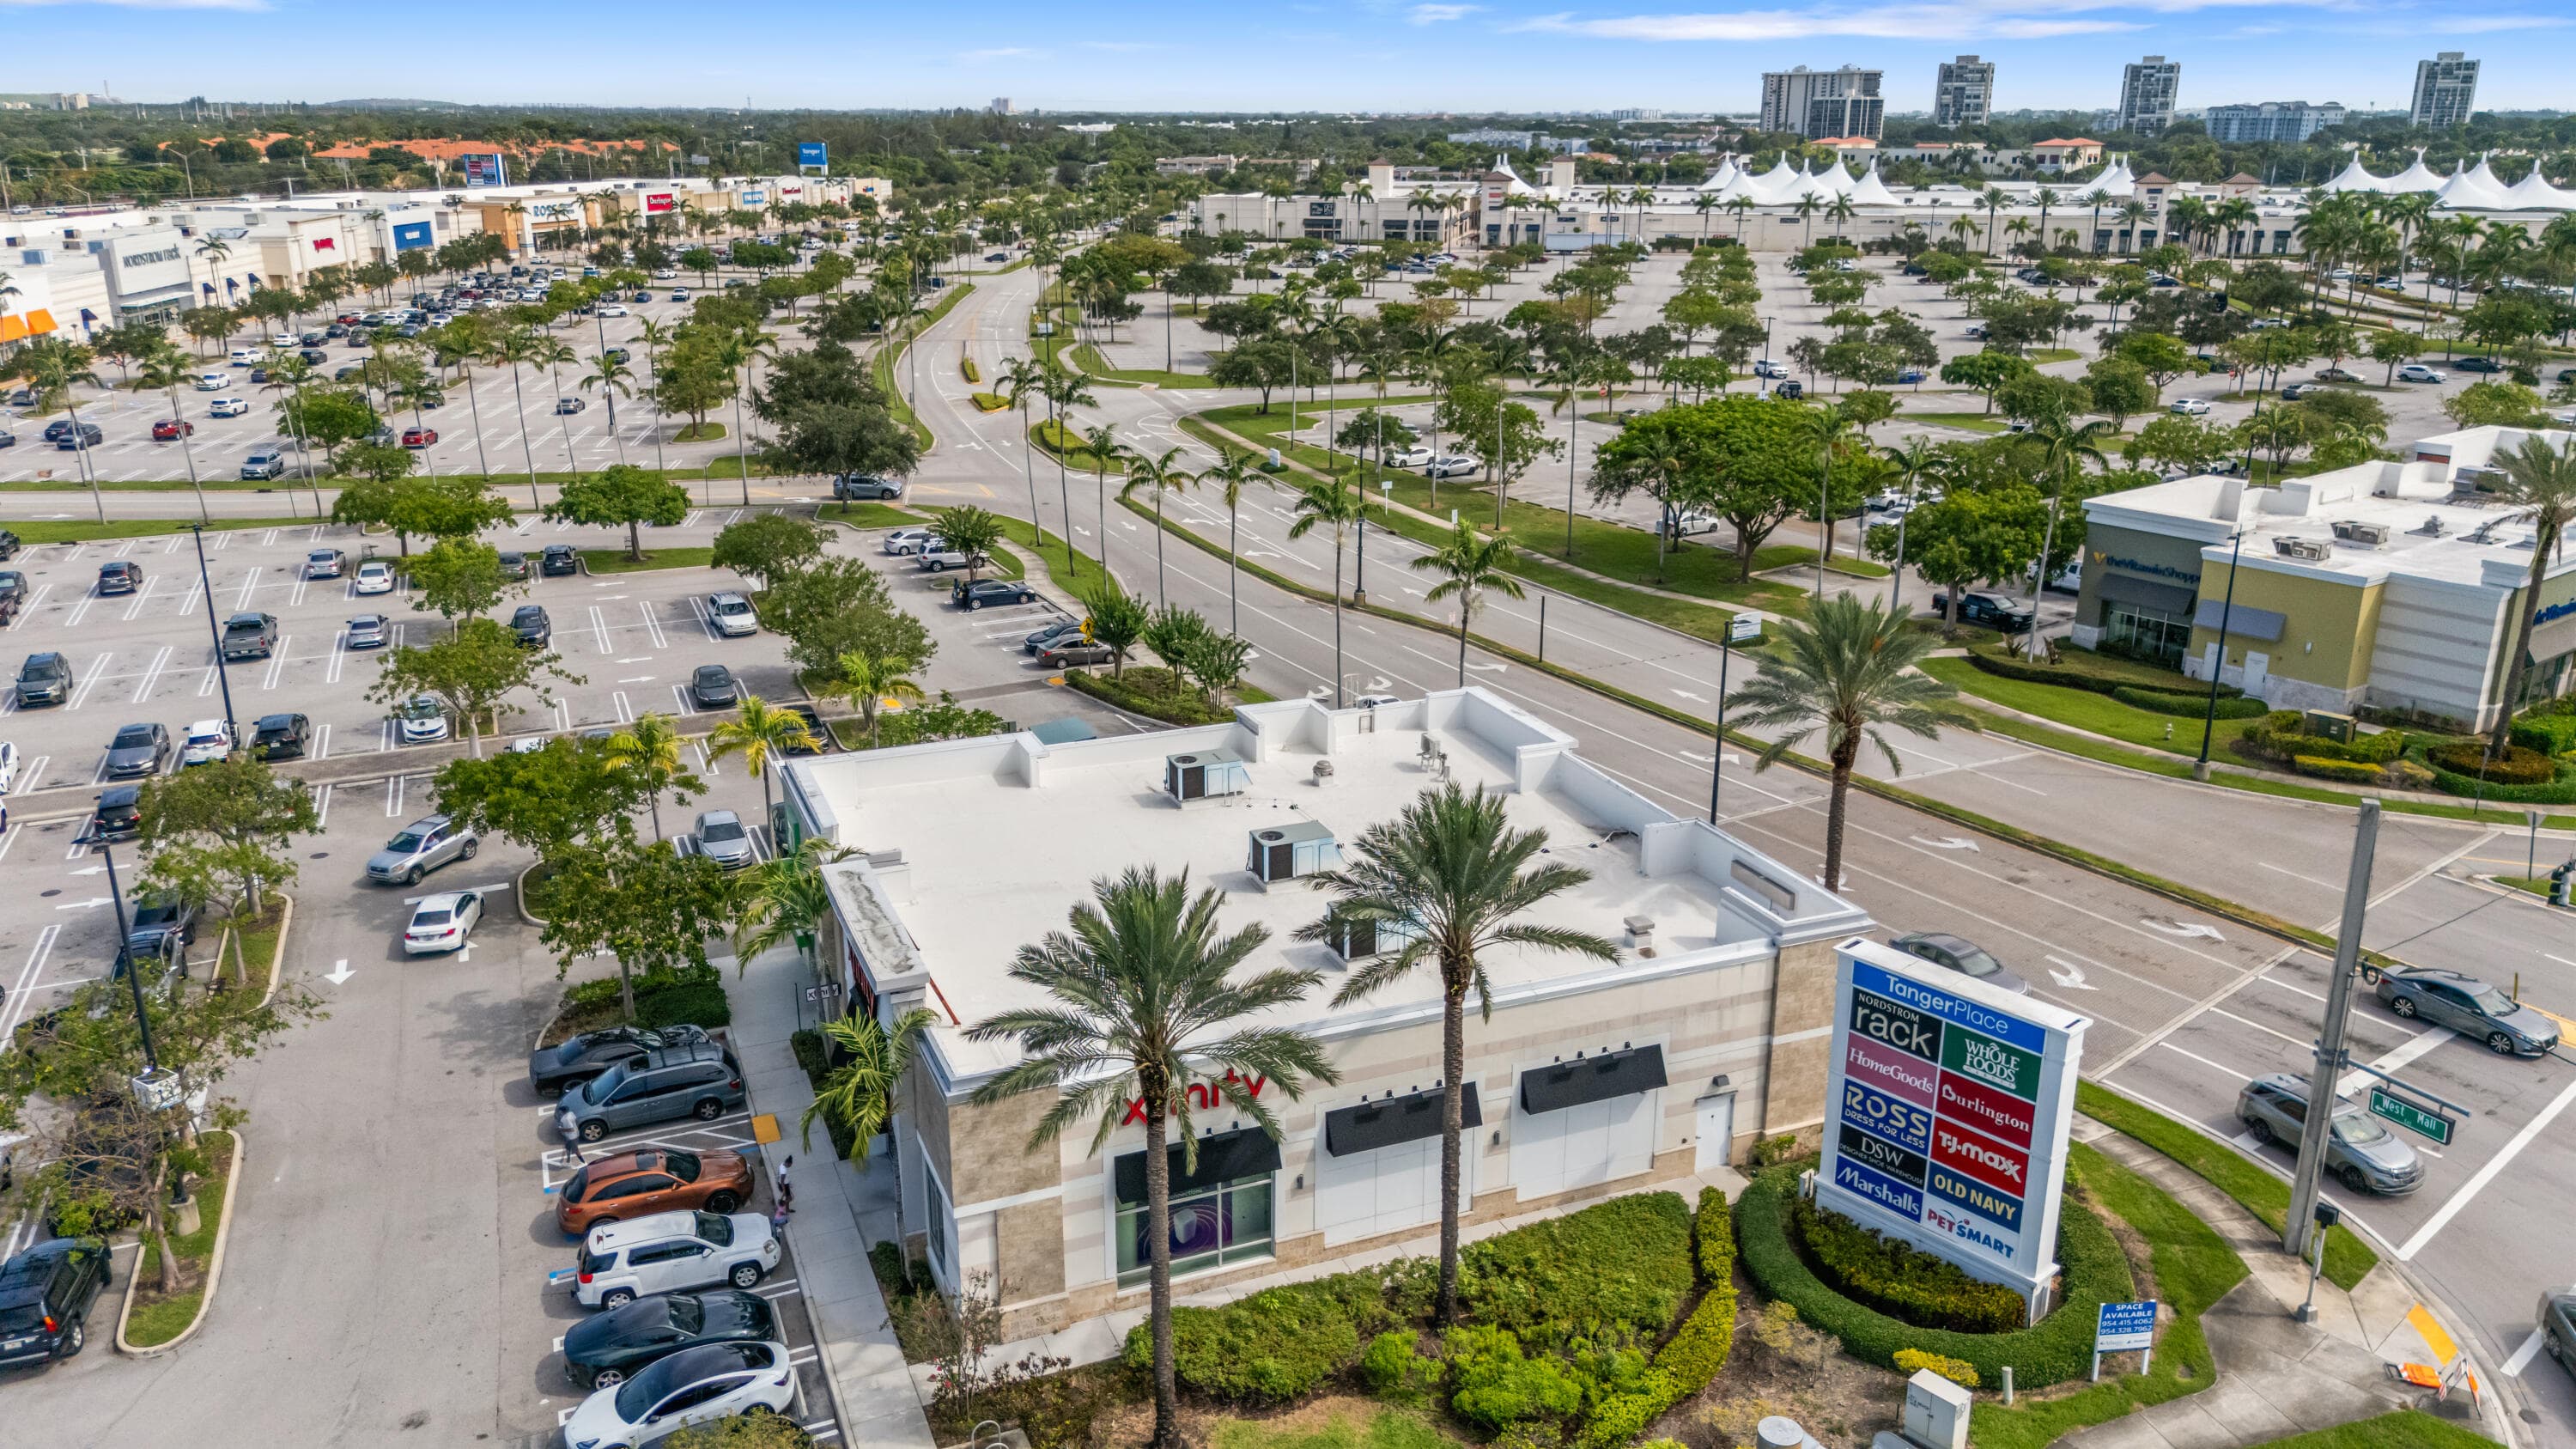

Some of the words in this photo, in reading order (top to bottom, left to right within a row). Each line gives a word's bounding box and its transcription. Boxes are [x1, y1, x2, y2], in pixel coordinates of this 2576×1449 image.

[1858, 992, 1920, 1023] NORDSTROM
[1856, 1006, 1933, 1057] rack
[1849, 1047, 1934, 1094] HomeGoods
[1964, 1038, 2020, 1072] WHOLE
[1965, 1053, 2017, 1083] FOODS
[1844, 1108, 1874, 1127] DRESS
[1877, 1122, 1898, 1137] FOR
[1900, 1131, 1926, 1149] LESS
[1846, 1085, 1929, 1137] ROSS
[1941, 1084, 2030, 1133] Burlington
[2381, 1097, 2405, 1117] West
[2416, 1111, 2437, 1130] Mall
[1838, 1142, 1868, 1160] DESIGNER
[1868, 1155, 1885, 1168] SHOE
[1885, 1164, 1924, 1185] WAREHOUSE
[1861, 1135, 1904, 1167] DSW
[1837, 1166, 1920, 1215] Marshalls
[1934, 1173, 1967, 1199] OLD
[1969, 1189, 2017, 1221] NAVY
[2104, 1310, 2153, 1319] AVAILABLE
[2115, 1303, 2144, 1312] SPACE
